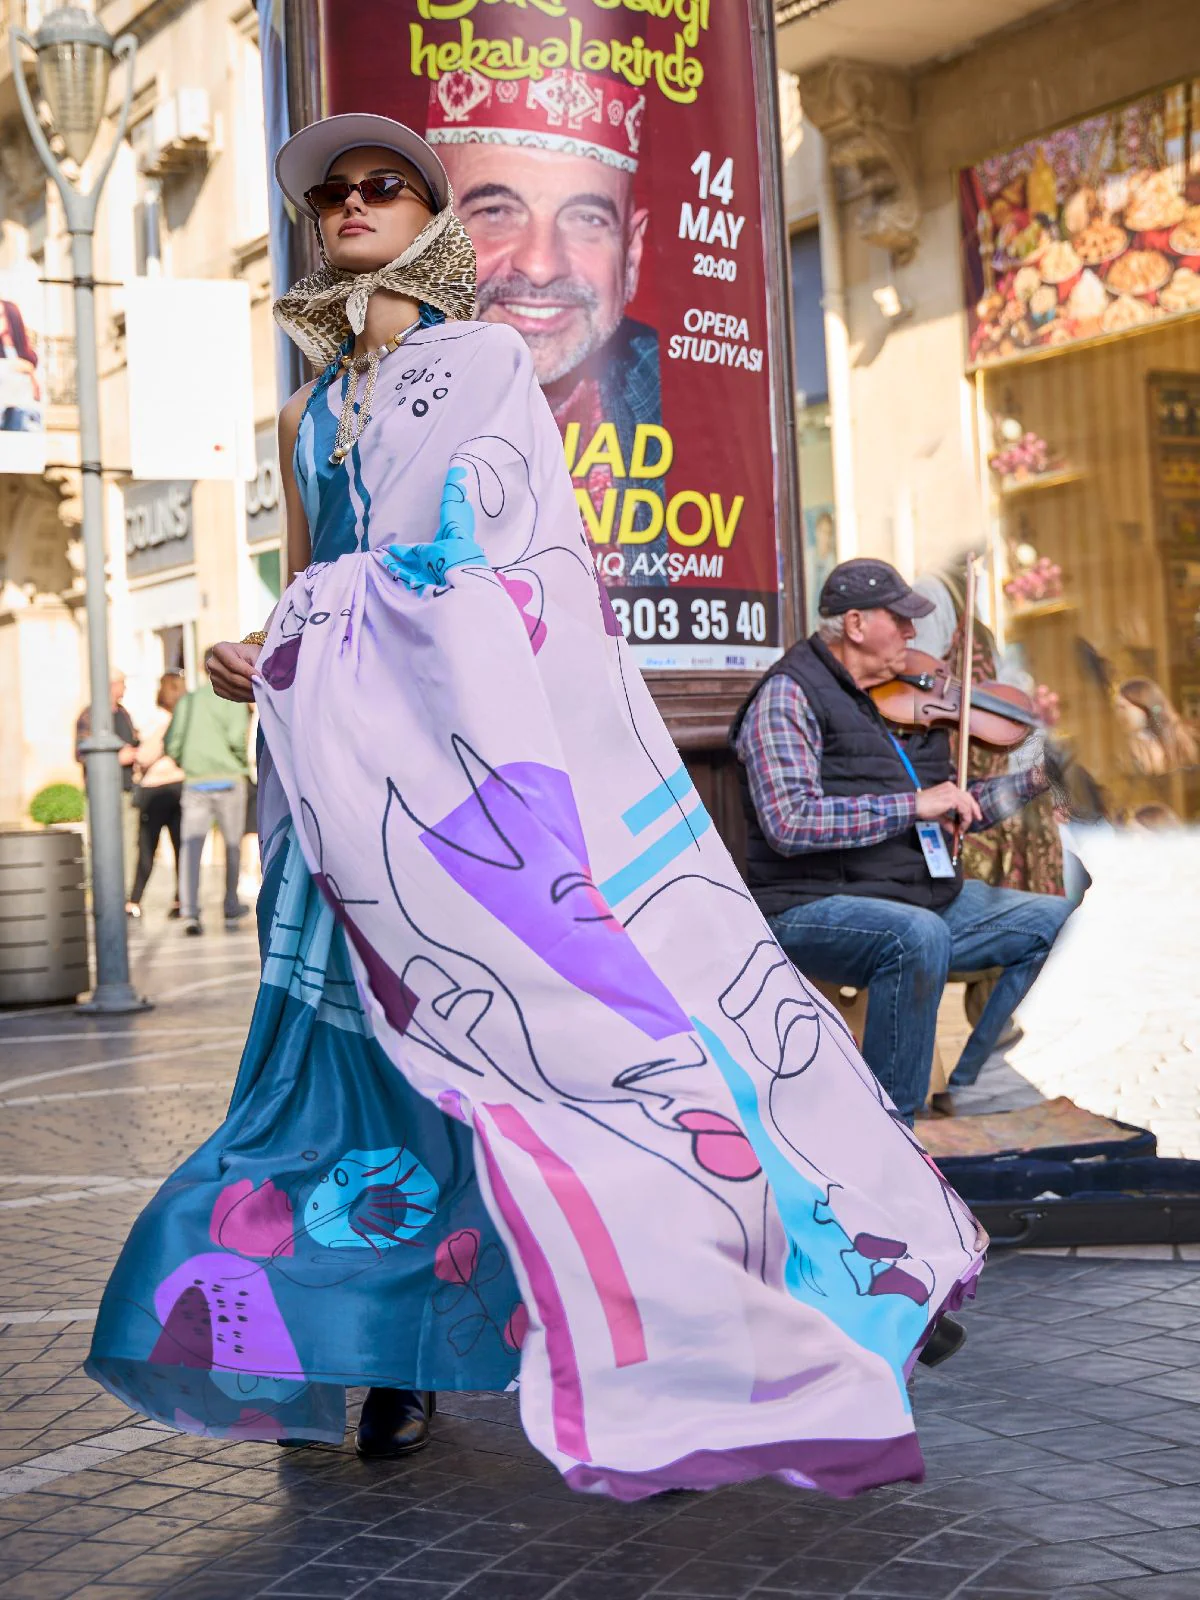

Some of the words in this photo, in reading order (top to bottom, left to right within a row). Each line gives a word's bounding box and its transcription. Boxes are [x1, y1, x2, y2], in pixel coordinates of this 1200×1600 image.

[690, 150, 734, 205] 14
[678, 202, 746, 250] MAY
[692, 253, 737, 282] 20:00
[683, 308, 750, 342] OPERA
[667, 334, 764, 373] STUDIYASI
[629, 552, 724, 583] AXŞAMI
[690, 597, 729, 641] 35
[736, 600, 767, 642] 40
